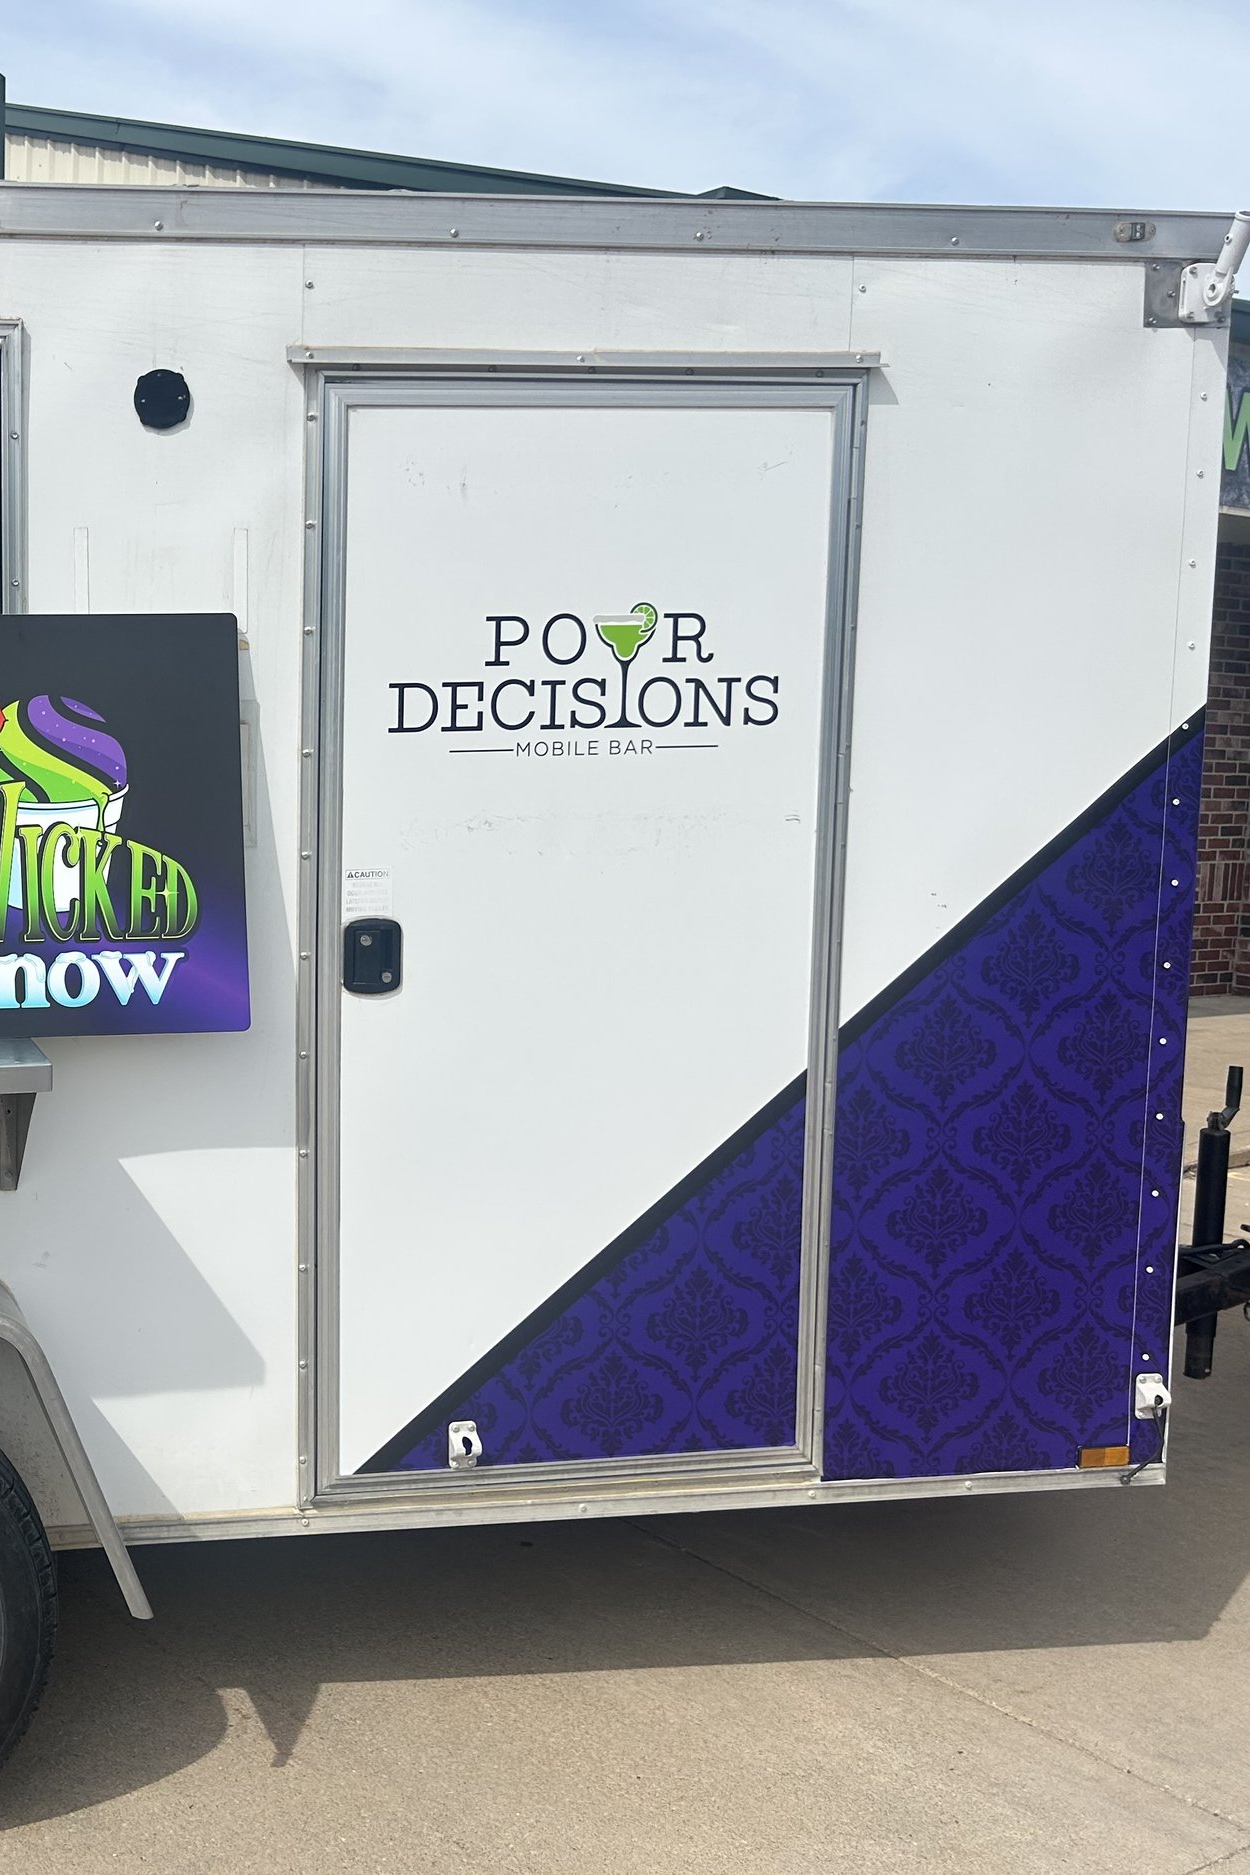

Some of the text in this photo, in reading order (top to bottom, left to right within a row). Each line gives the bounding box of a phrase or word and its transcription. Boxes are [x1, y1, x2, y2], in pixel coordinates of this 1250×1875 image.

[388, 674, 780, 734] DECISIONS
[515, 739, 654, 758] MOBILE BAR
[354, 870, 388, 879] CAUTION
